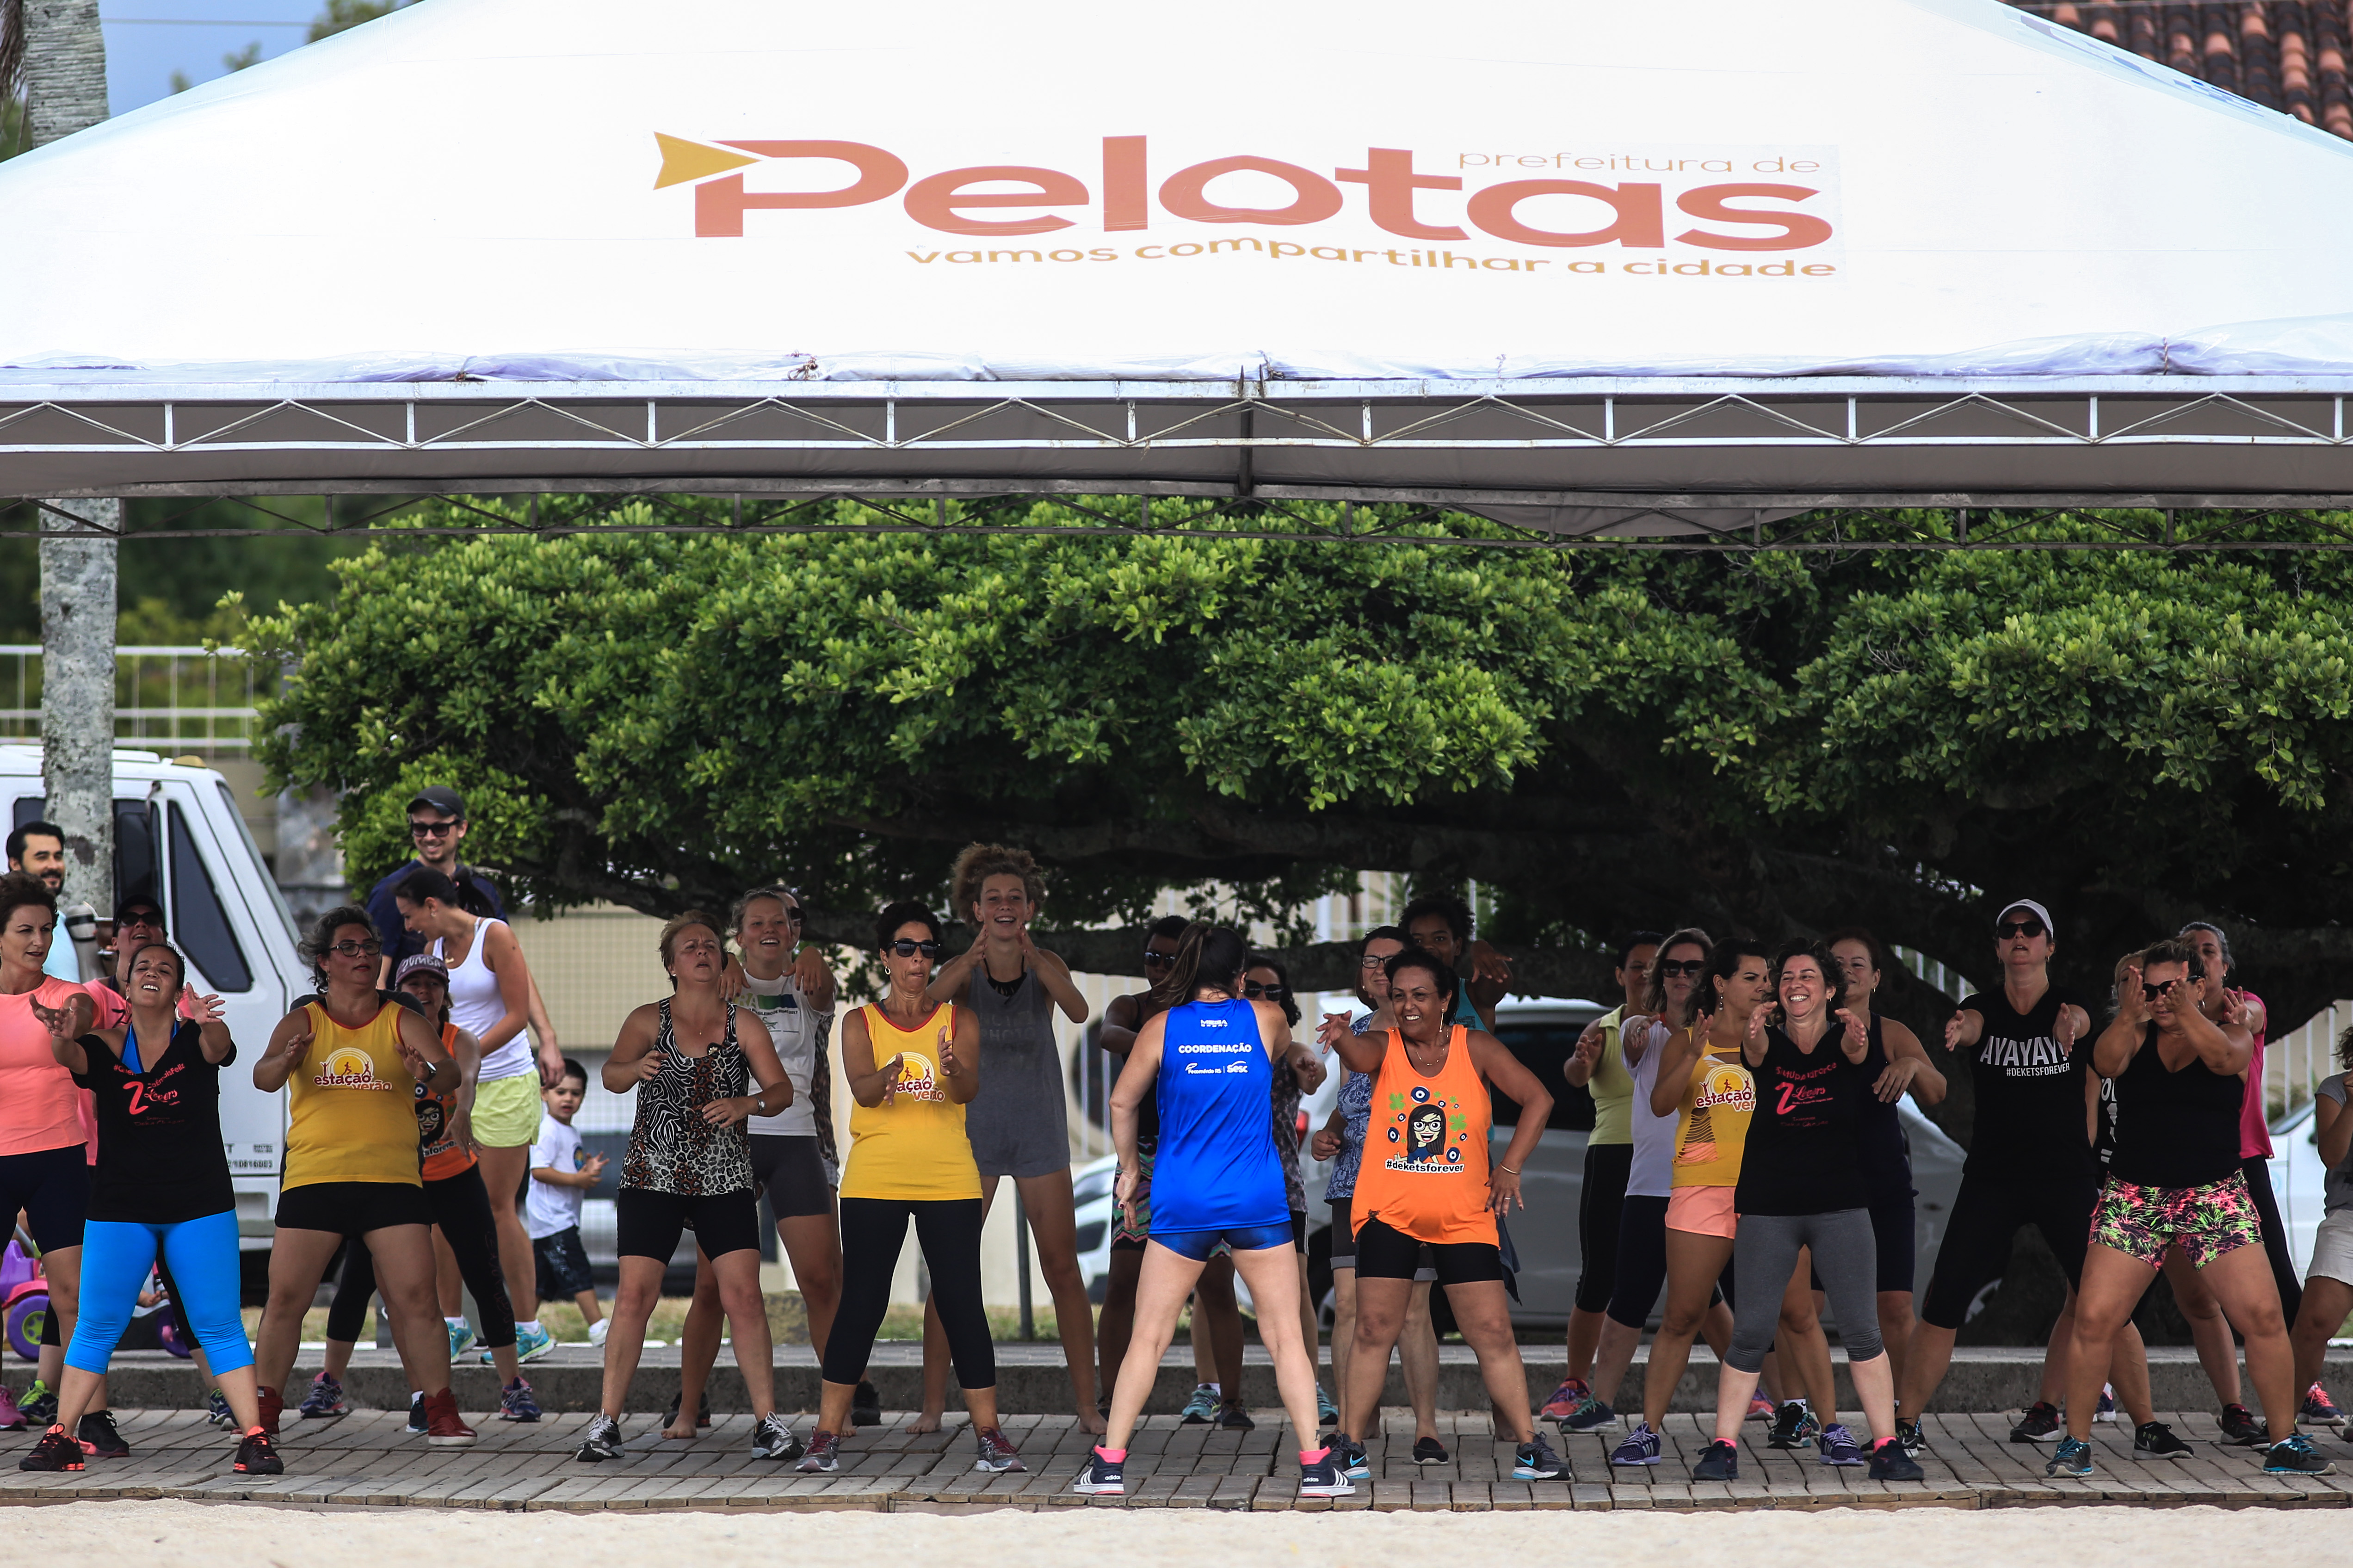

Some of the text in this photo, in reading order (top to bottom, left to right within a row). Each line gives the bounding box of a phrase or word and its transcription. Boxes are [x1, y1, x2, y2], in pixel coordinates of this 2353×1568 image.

[1459, 152, 1821, 173] prefeitura de
[695, 135, 1834, 252] Pelotas
[904, 236, 1837, 277] vamos compartilhar a cidade
[402, 956, 441, 972] ZUMBA
[1178, 1042, 1252, 1054] COORDENAÇÃO
[2006, 1062, 2070, 1077] #DEKETSFOREVER
[314, 1073, 371, 1086] estação
[896, 1078, 933, 1093] ação
[1696, 1089, 1753, 1107] estação
[1732, 1100, 1756, 1111] ver
[1386, 1160, 1464, 1172] #deketsforever
